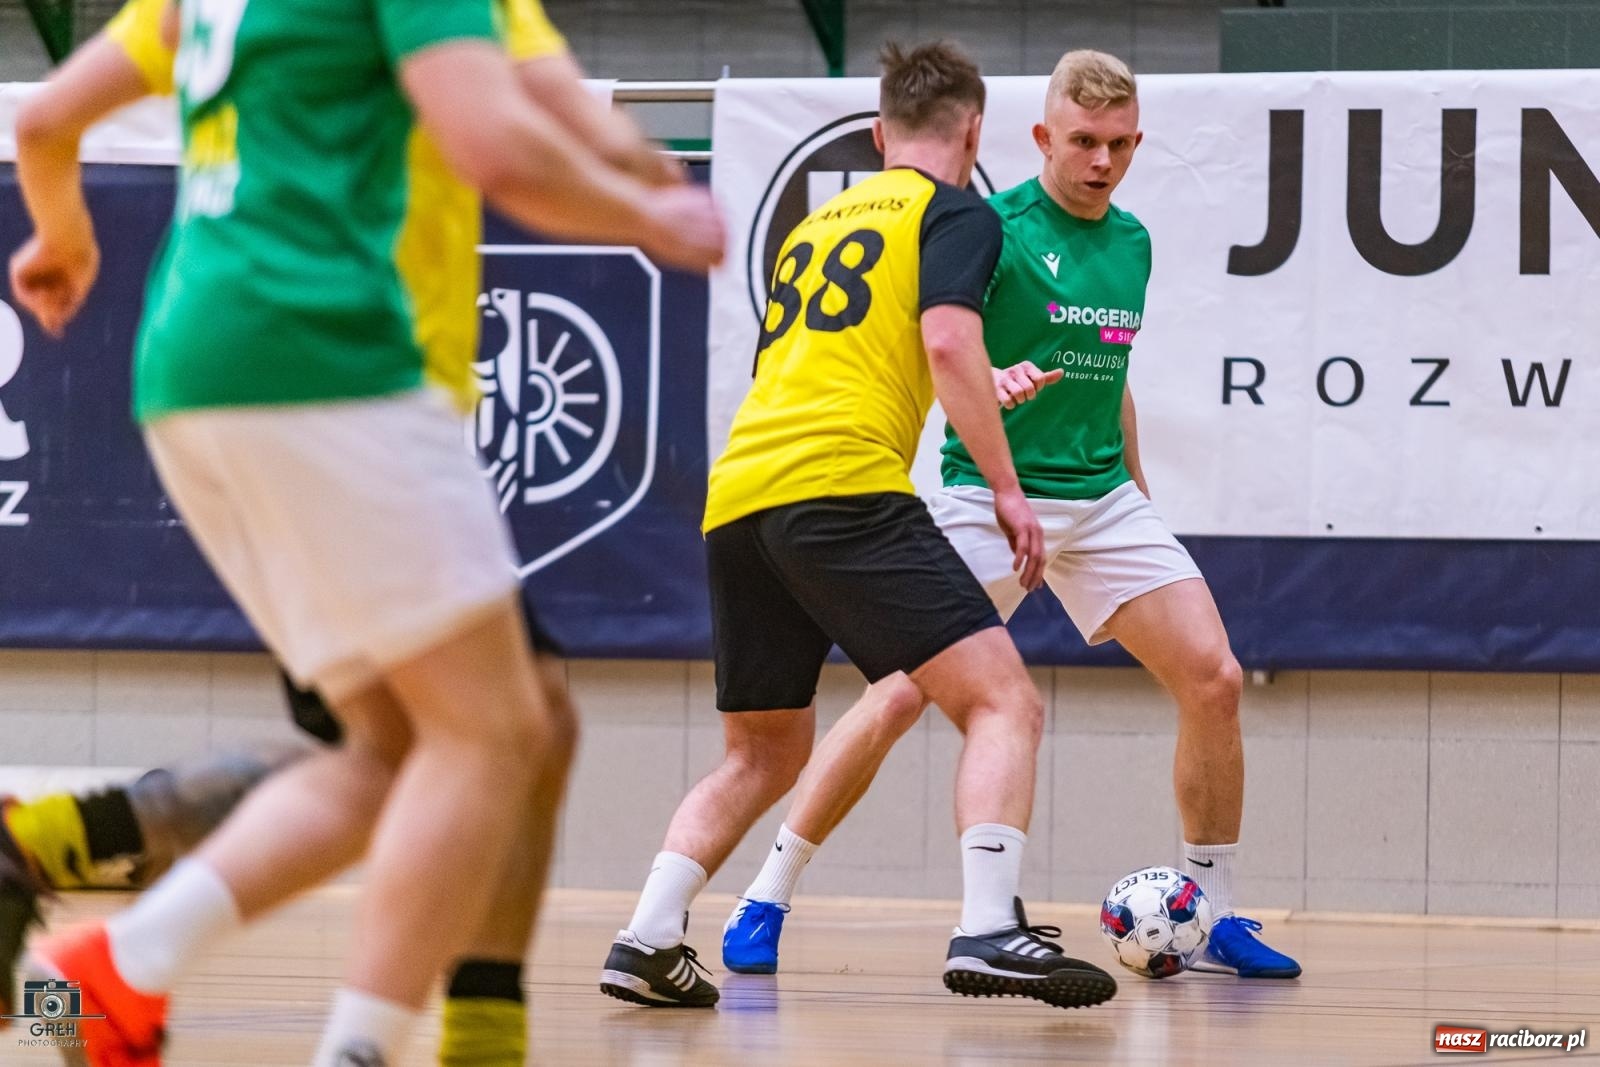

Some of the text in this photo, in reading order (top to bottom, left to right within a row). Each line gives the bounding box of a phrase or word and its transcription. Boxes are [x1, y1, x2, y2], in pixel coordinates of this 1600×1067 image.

[758, 228, 885, 353] 88
[1049, 304, 1140, 330] DROGERIA
[1104, 330, 1114, 340] W
[1101, 374, 1114, 382] SPA
[1115, 871, 1169, 896] SELECT
